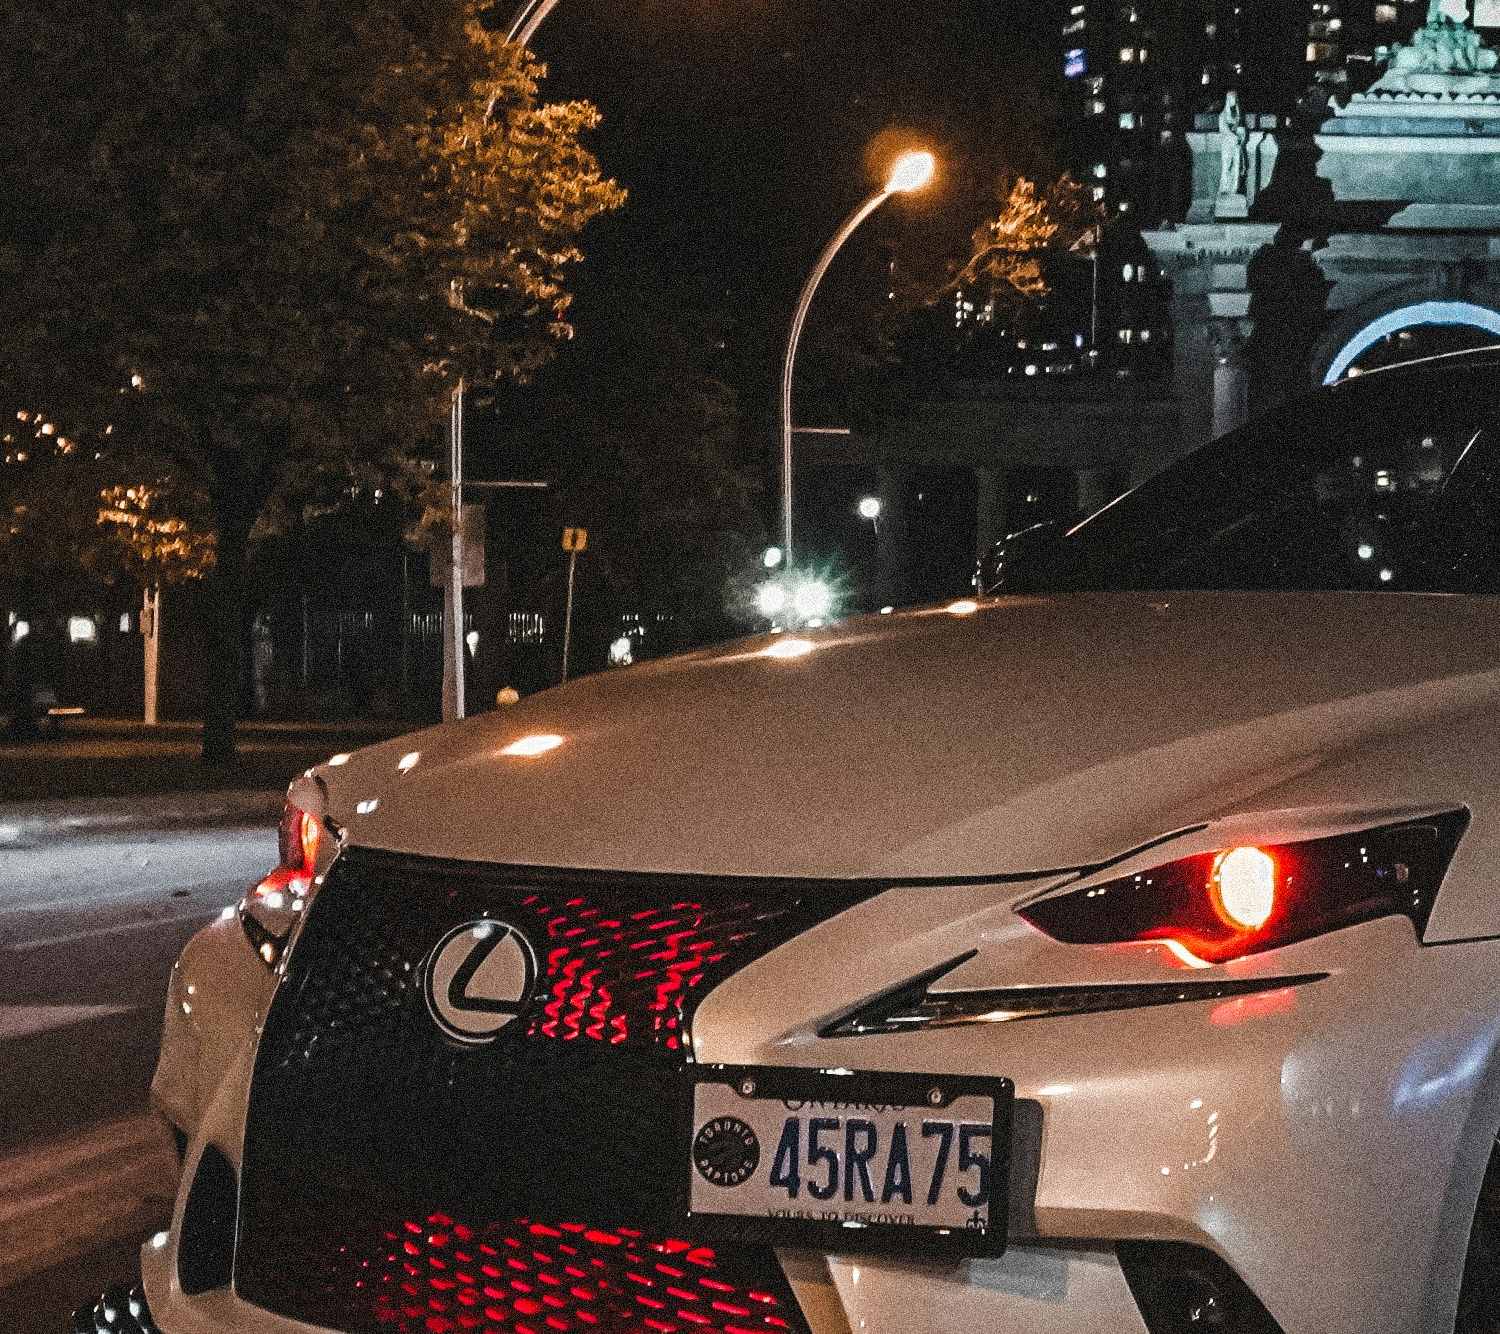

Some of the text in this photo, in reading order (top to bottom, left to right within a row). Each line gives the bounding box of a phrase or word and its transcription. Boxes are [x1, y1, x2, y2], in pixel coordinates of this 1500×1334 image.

[699, 1120, 754, 1145] TORONTO
[700, 1158, 754, 1183] RAPTORS
[769, 1117, 992, 1207] 45RA75
